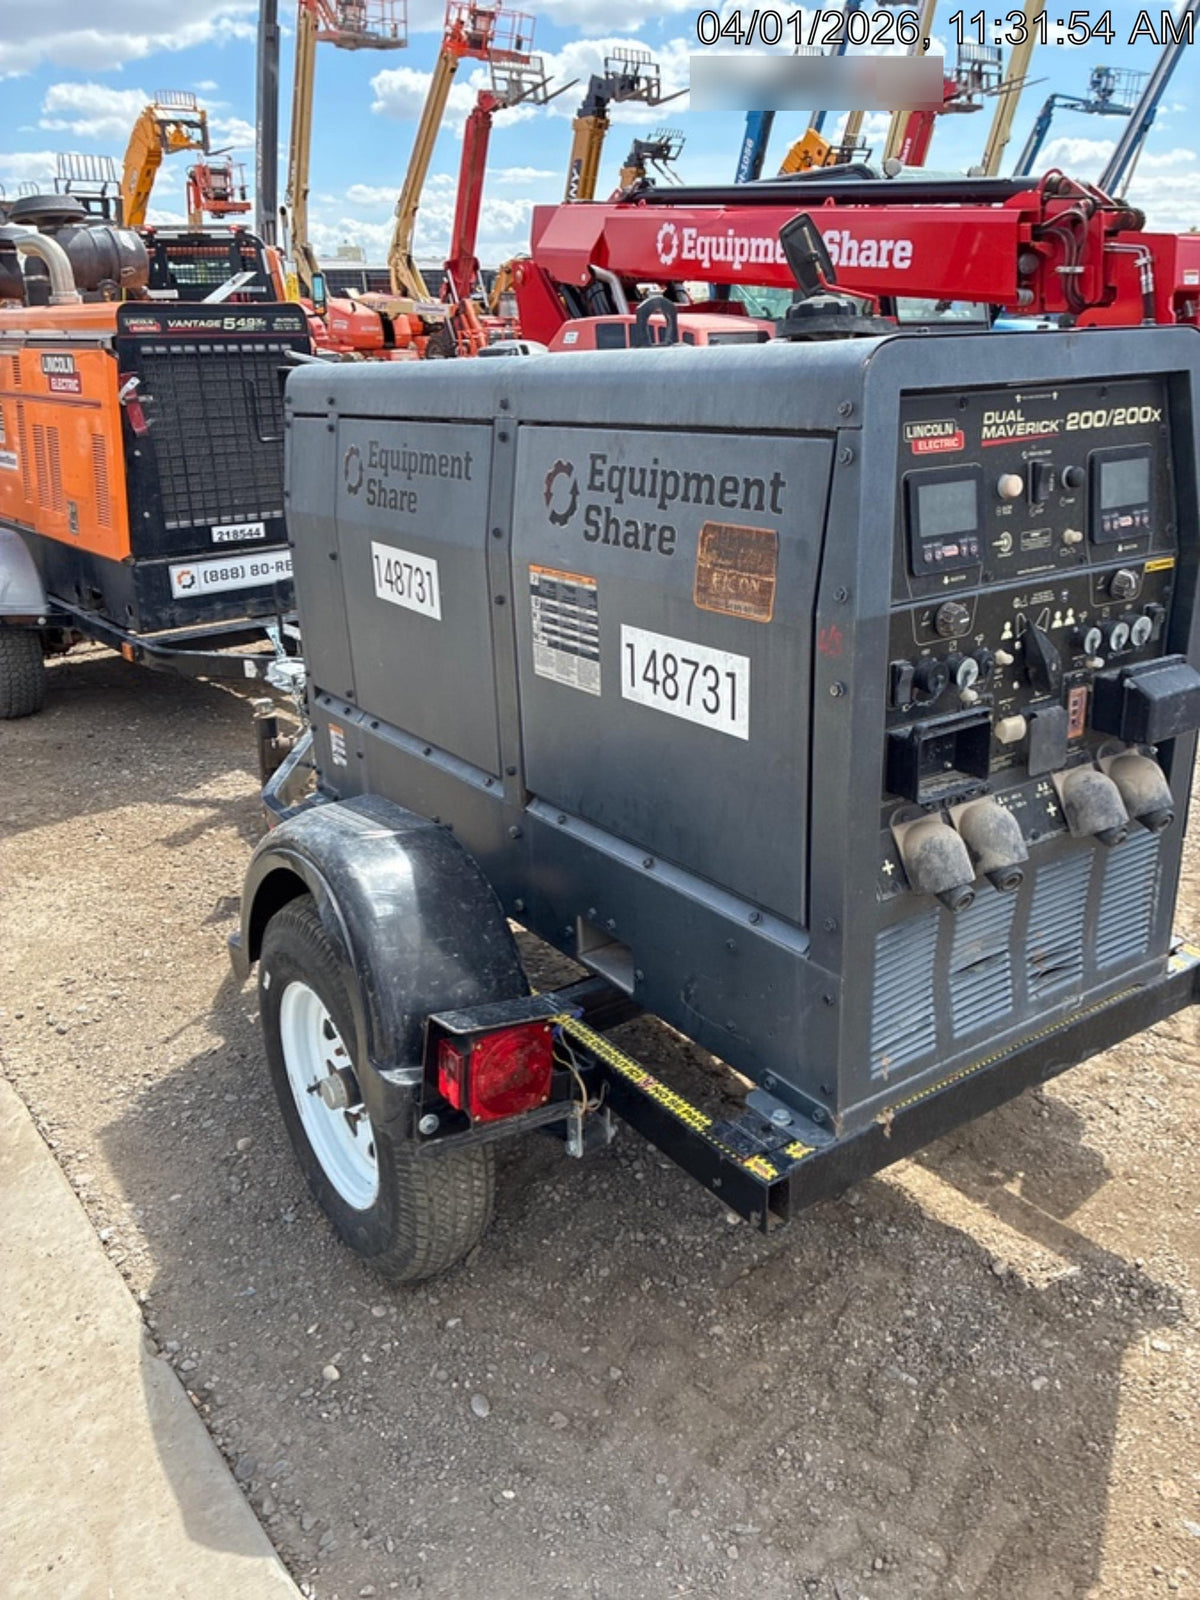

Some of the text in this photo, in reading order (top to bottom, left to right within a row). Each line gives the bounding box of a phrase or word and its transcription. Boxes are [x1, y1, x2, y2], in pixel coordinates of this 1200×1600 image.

[822, 229, 913, 269] Share
[167, 319, 222, 328] VANTAGE
[42, 356, 74, 373] LINCOLN
[51, 378, 80, 392] ELECTRIC
[983, 409, 1025, 425] DUAL
[906, 422, 954, 438] LINCOLN
[981, 421, 1060, 439] MAVERICK
[918, 437, 960, 450] ELECTRIC
[368, 440, 473, 481] Equipment
[587, 453, 787, 515] Equipment
[366, 478, 418, 514] Share
[216, 527, 261, 541] 218544
[583, 504, 677, 556] Share
[203, 569, 245, 584] (888)
[374, 554, 435, 608] 148731
[626, 642, 737, 721] 148731
